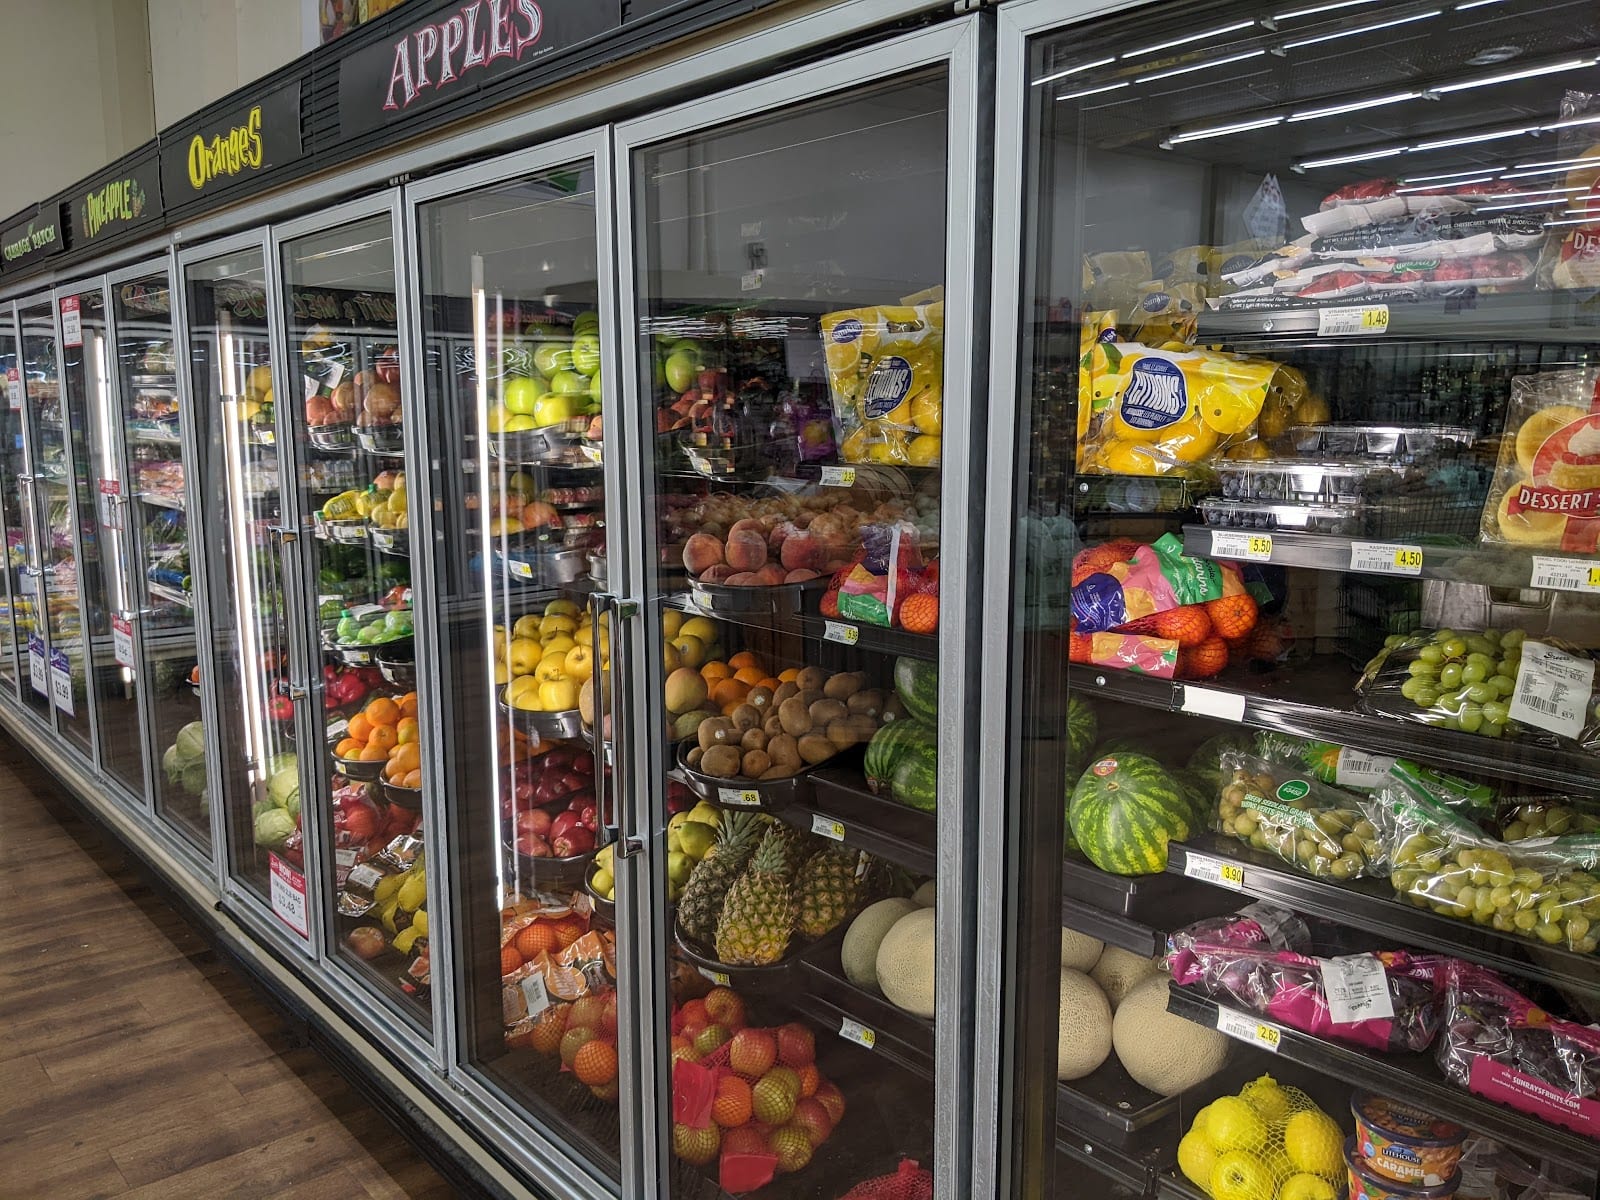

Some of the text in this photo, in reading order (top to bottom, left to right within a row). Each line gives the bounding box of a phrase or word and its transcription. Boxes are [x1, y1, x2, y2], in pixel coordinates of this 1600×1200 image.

[382, 0, 543, 110] APPLES
[86, 178, 133, 239] PINEAPPLE
[4, 223, 57, 262] CABBAGE PATCH
[1367, 311, 1387, 326] 1.48
[1127, 370, 1180, 415] CITRONS
[1519, 489, 1593, 510] DESSERT
[1253, 539, 1271, 553] 5.50
[1400, 551, 1421, 566] 4.50
[1261, 798, 1290, 813] SEEDLESS
[1225, 866, 1242, 882] 3.90
[1261, 1026, 1279, 1043] 2.62
[1512, 1076, 1581, 1110] SUNRAYSFRUITS.COM
[1382, 1147, 1421, 1165] LITEHOUSE
[1376, 1157, 1426, 1178] CARAMEL
